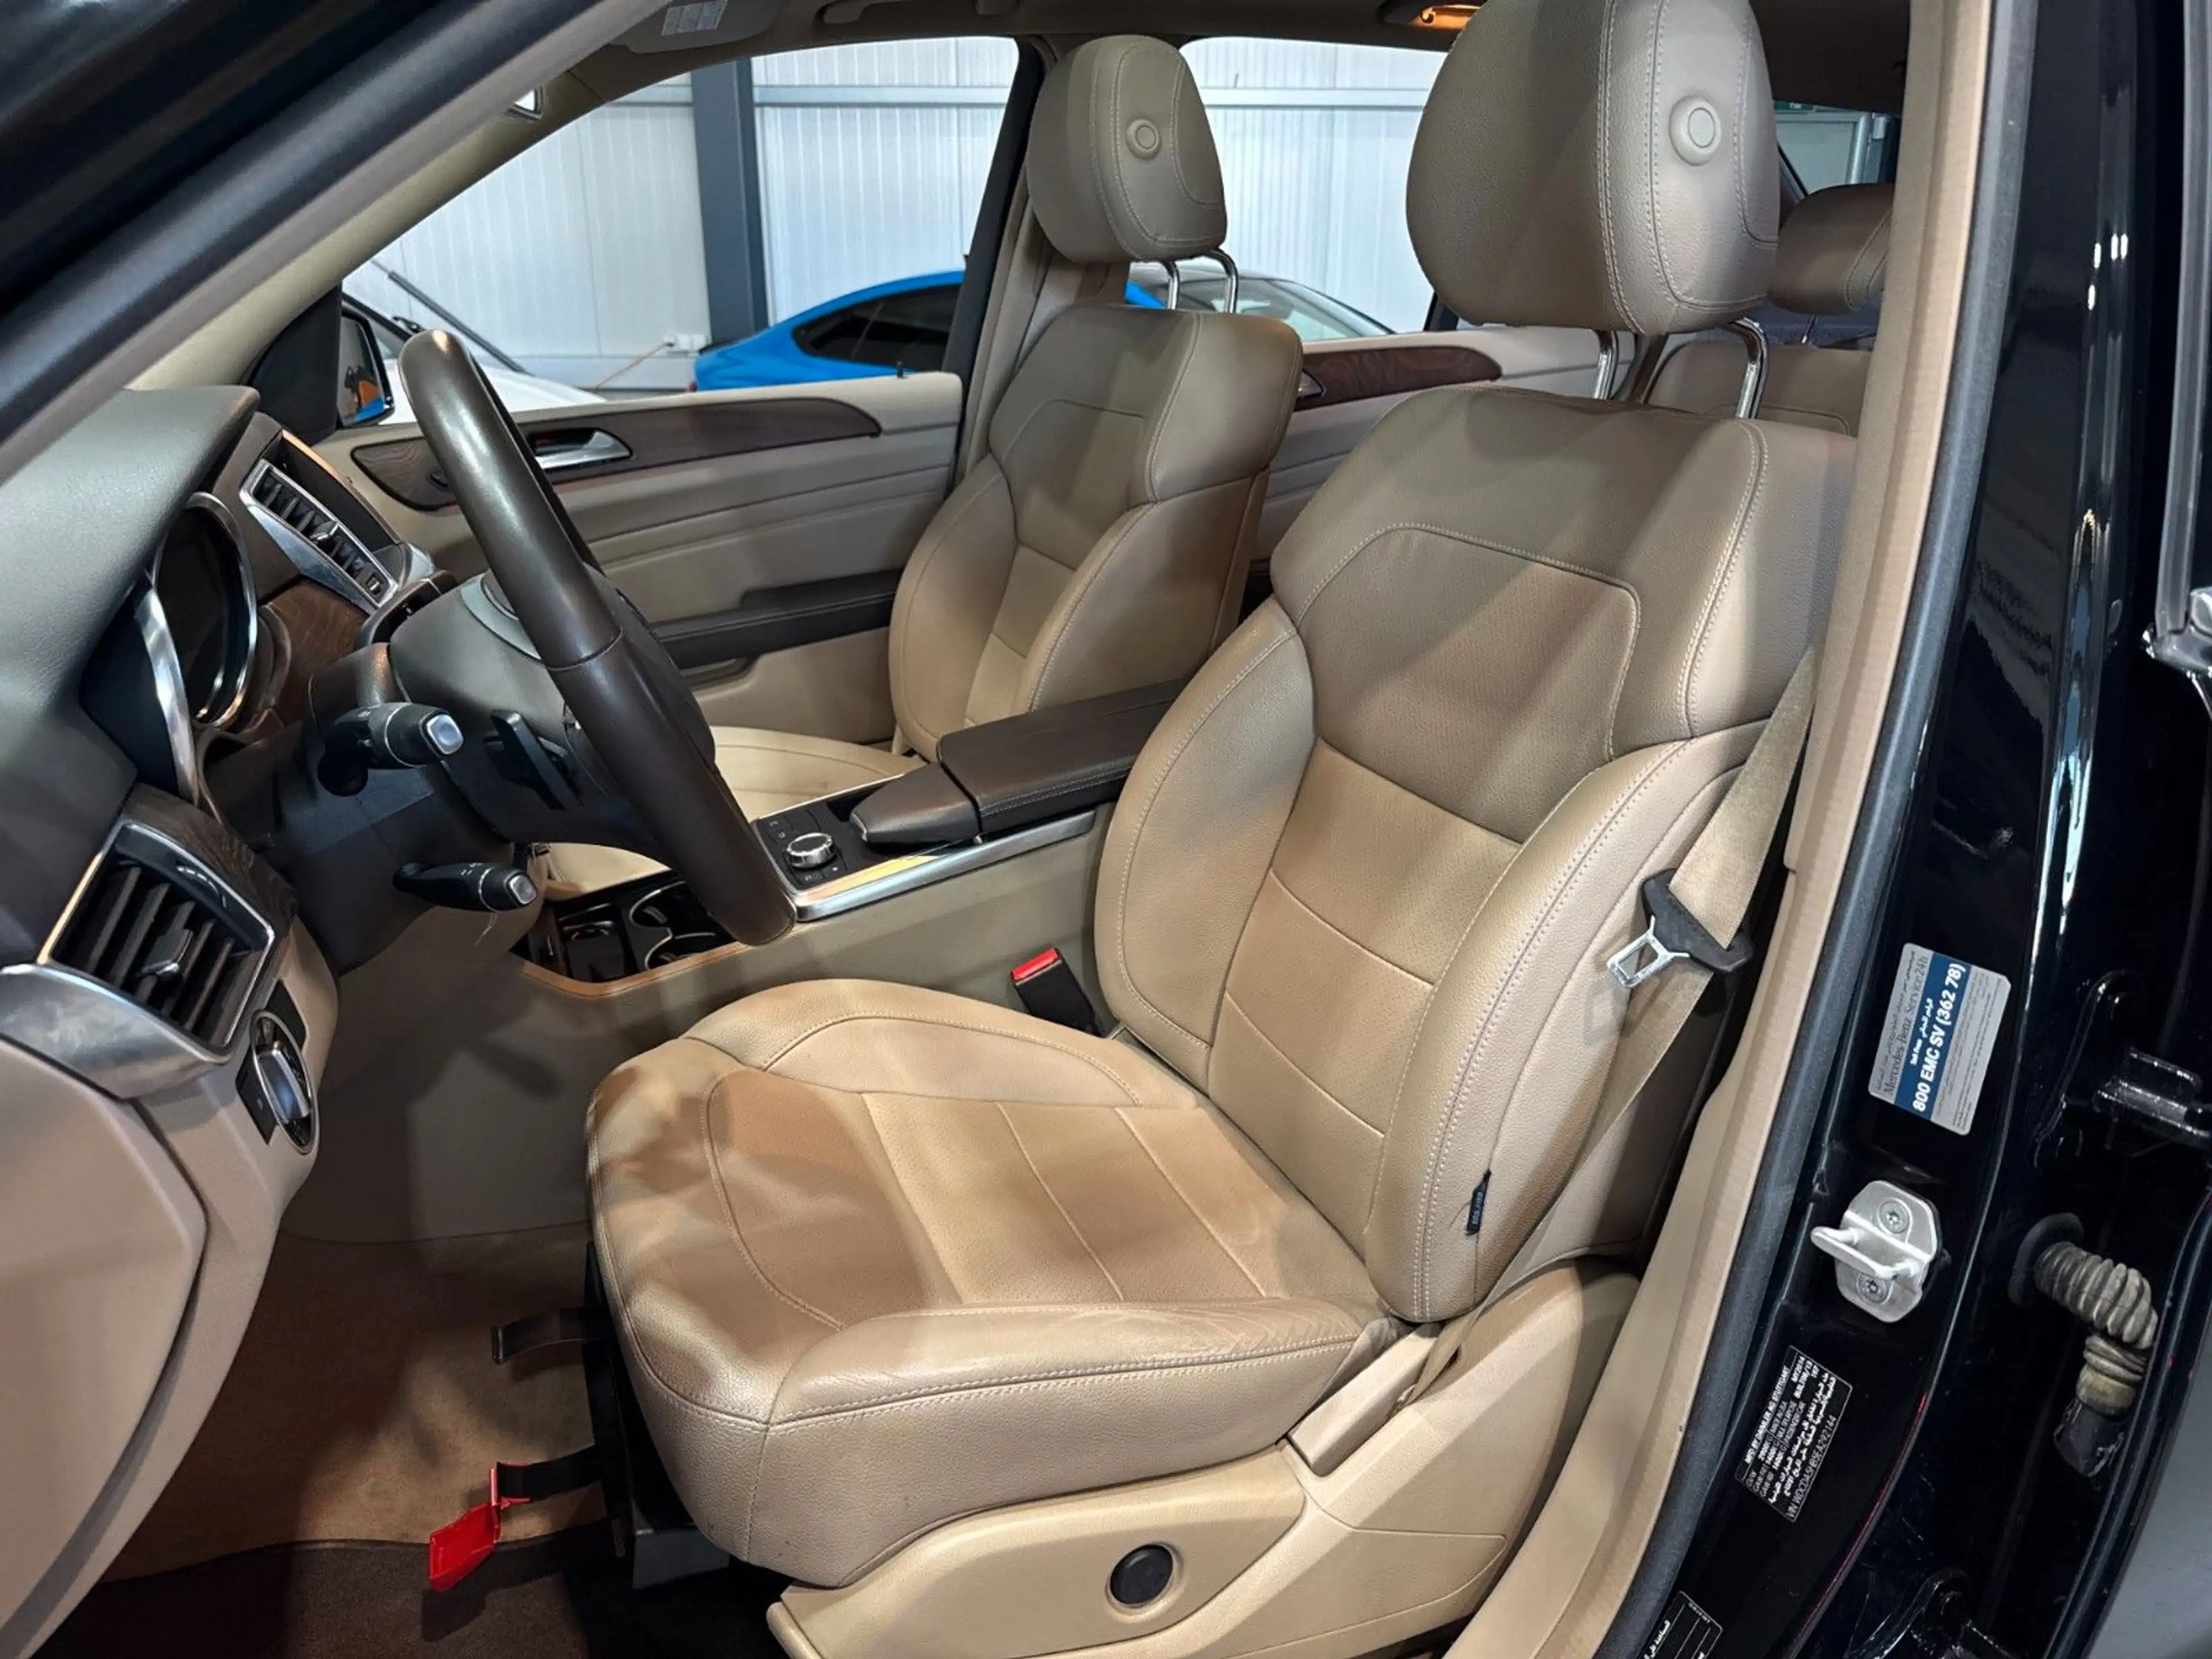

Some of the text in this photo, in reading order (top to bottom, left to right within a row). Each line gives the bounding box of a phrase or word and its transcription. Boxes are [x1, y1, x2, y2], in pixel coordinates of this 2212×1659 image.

[1945, 963, 1965, 988] 78)
[1936, 990, 1955, 1025] (362
[1929, 1024, 1944, 1047] SV
[1921, 1048, 1939, 1081] EMC
[1912, 1082, 1930, 1111] 800
